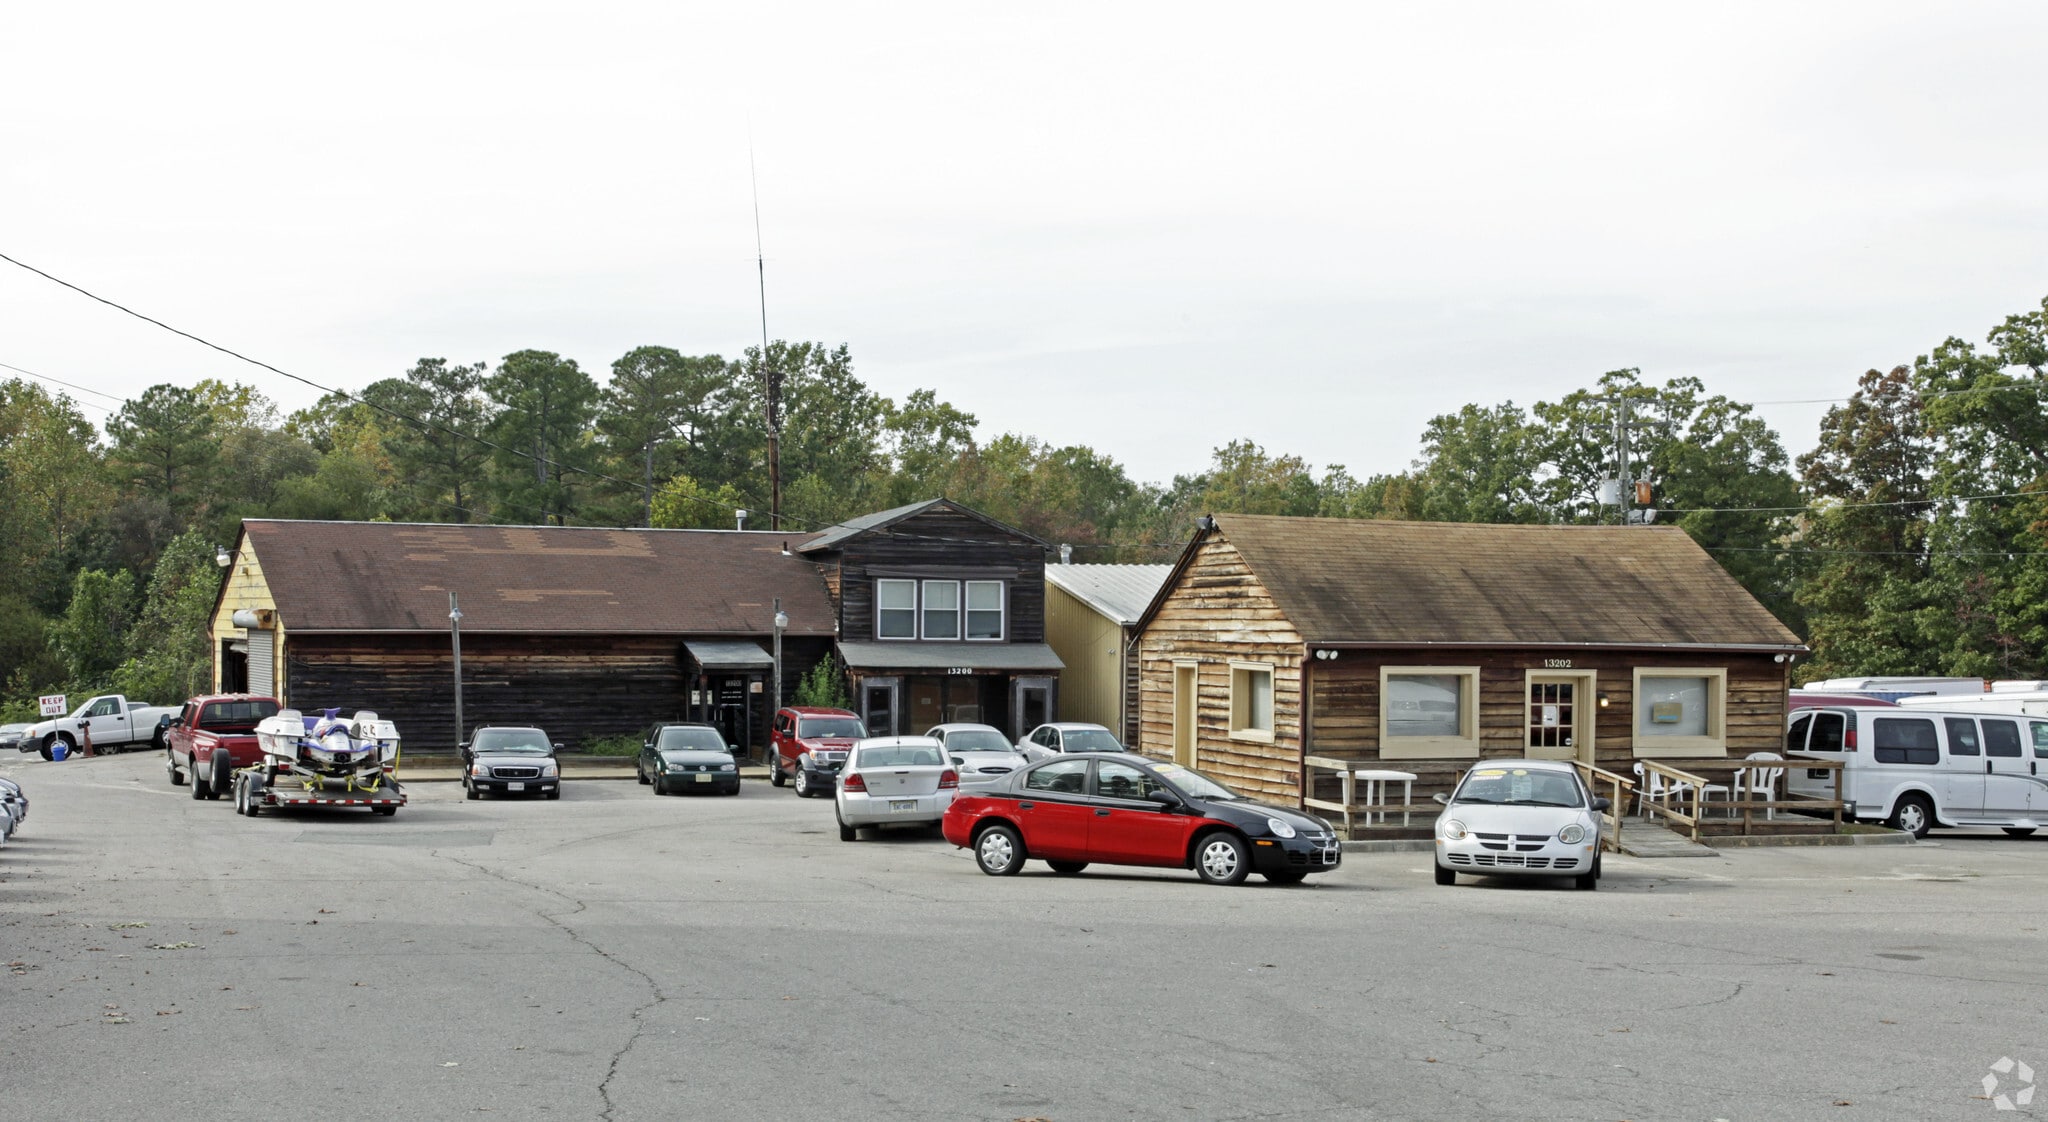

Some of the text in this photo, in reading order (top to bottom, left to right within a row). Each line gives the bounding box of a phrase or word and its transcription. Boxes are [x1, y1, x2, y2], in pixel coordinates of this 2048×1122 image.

[1544, 659, 1572, 668] 13202
[947, 667, 972, 675] 13200
[41, 696, 64, 705] KEEP
[46, 706, 61, 714] OUT
